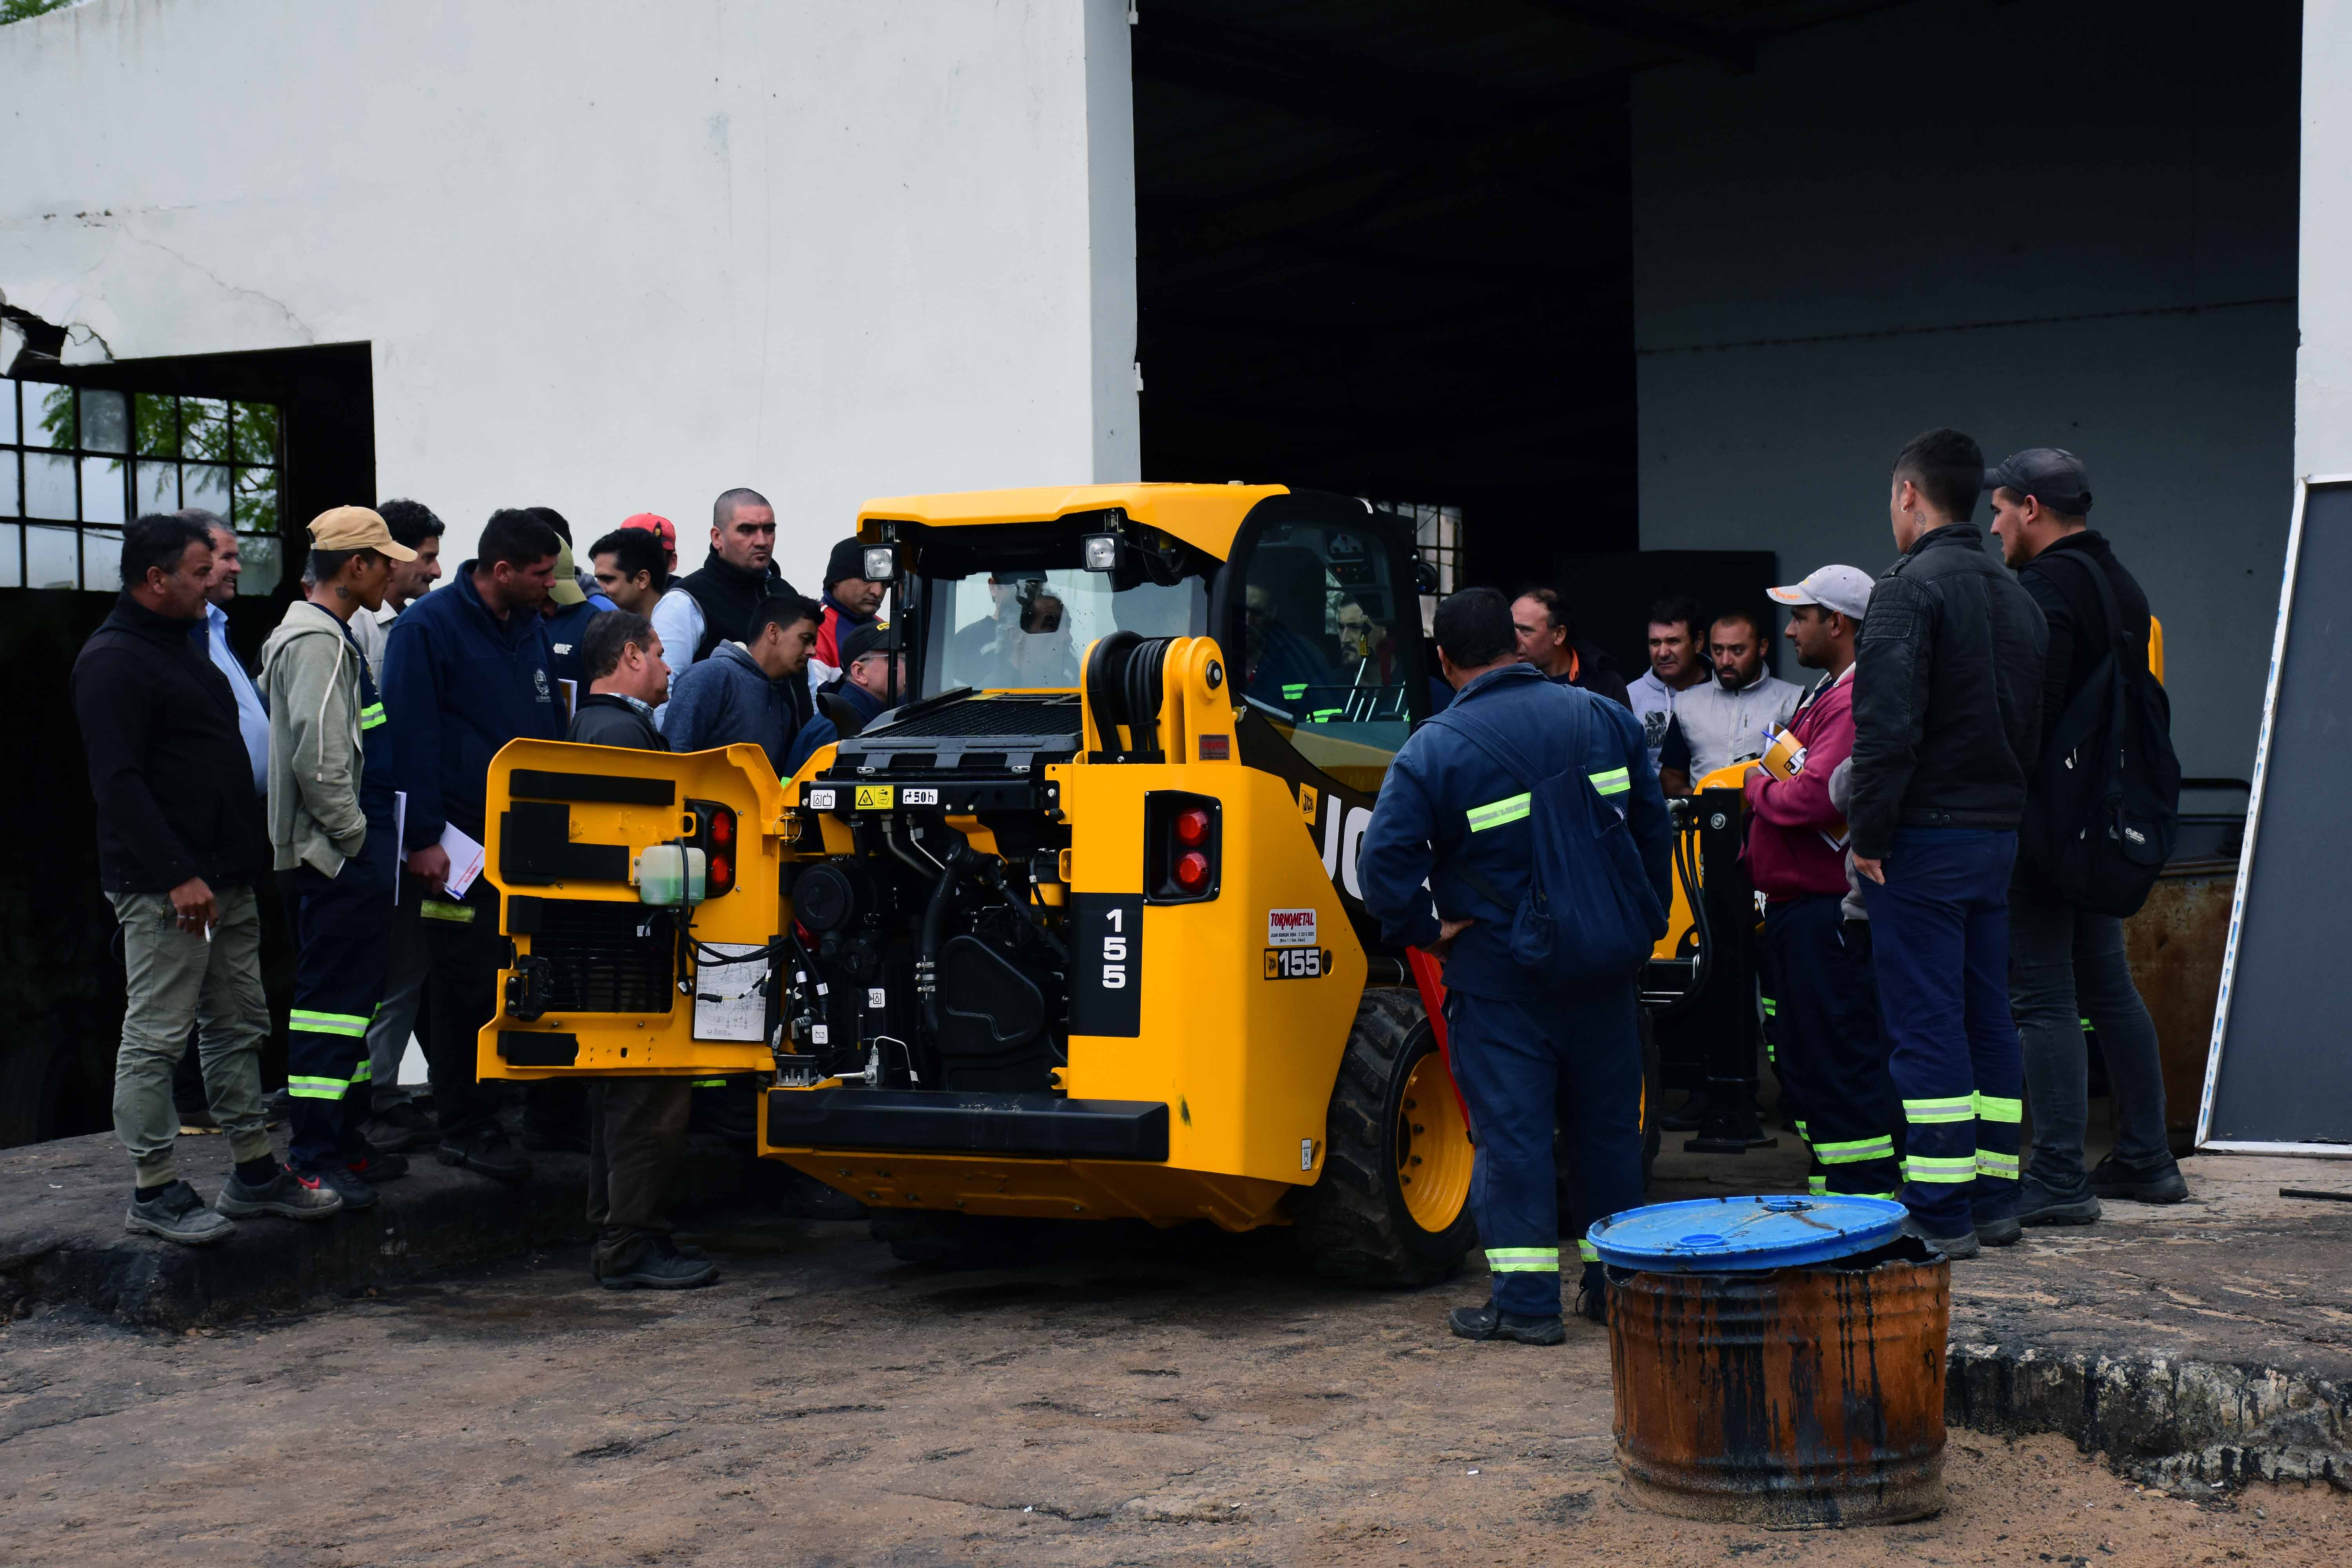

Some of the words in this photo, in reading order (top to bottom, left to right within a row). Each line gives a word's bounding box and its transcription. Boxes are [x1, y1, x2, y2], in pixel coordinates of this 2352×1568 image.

[1304, 793, 1313, 811] JCB
[1271, 912, 1314, 930] TORNOMETAL
[1279, 949, 1319, 976] 155
